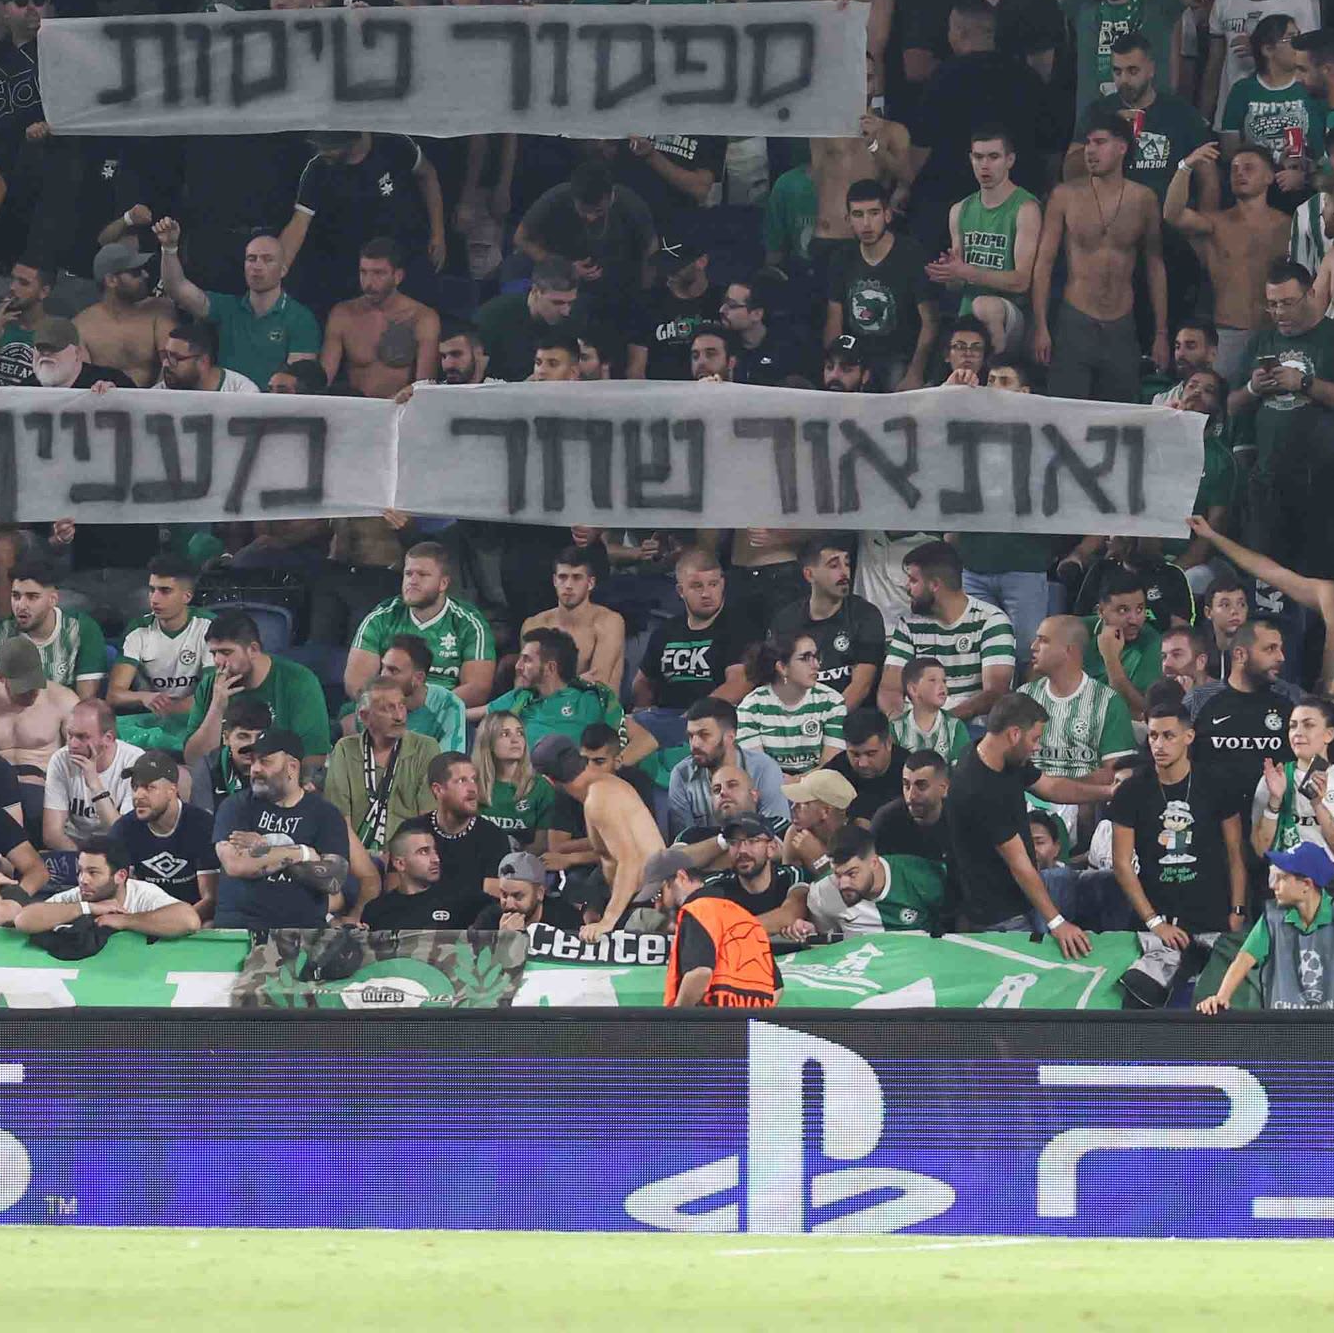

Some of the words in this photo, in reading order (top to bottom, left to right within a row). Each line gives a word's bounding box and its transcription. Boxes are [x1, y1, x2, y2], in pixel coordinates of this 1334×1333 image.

[96, 19, 415, 110] טיסות
[451, 20, 817, 114] ספסור
[449, 416, 706, 516] שחר
[732, 415, 923, 516] אור
[938, 419, 1149, 519] ואת
[660, 647, 710, 673] FCK
[817, 664, 852, 681] LVO
[151, 675, 197, 689] ONDA
[1036, 747, 1095, 761] OLVO
[1210, 735, 1282, 751] VOLVO
[257, 810, 304, 836] BEAST
[527, 922, 676, 964] Cente
